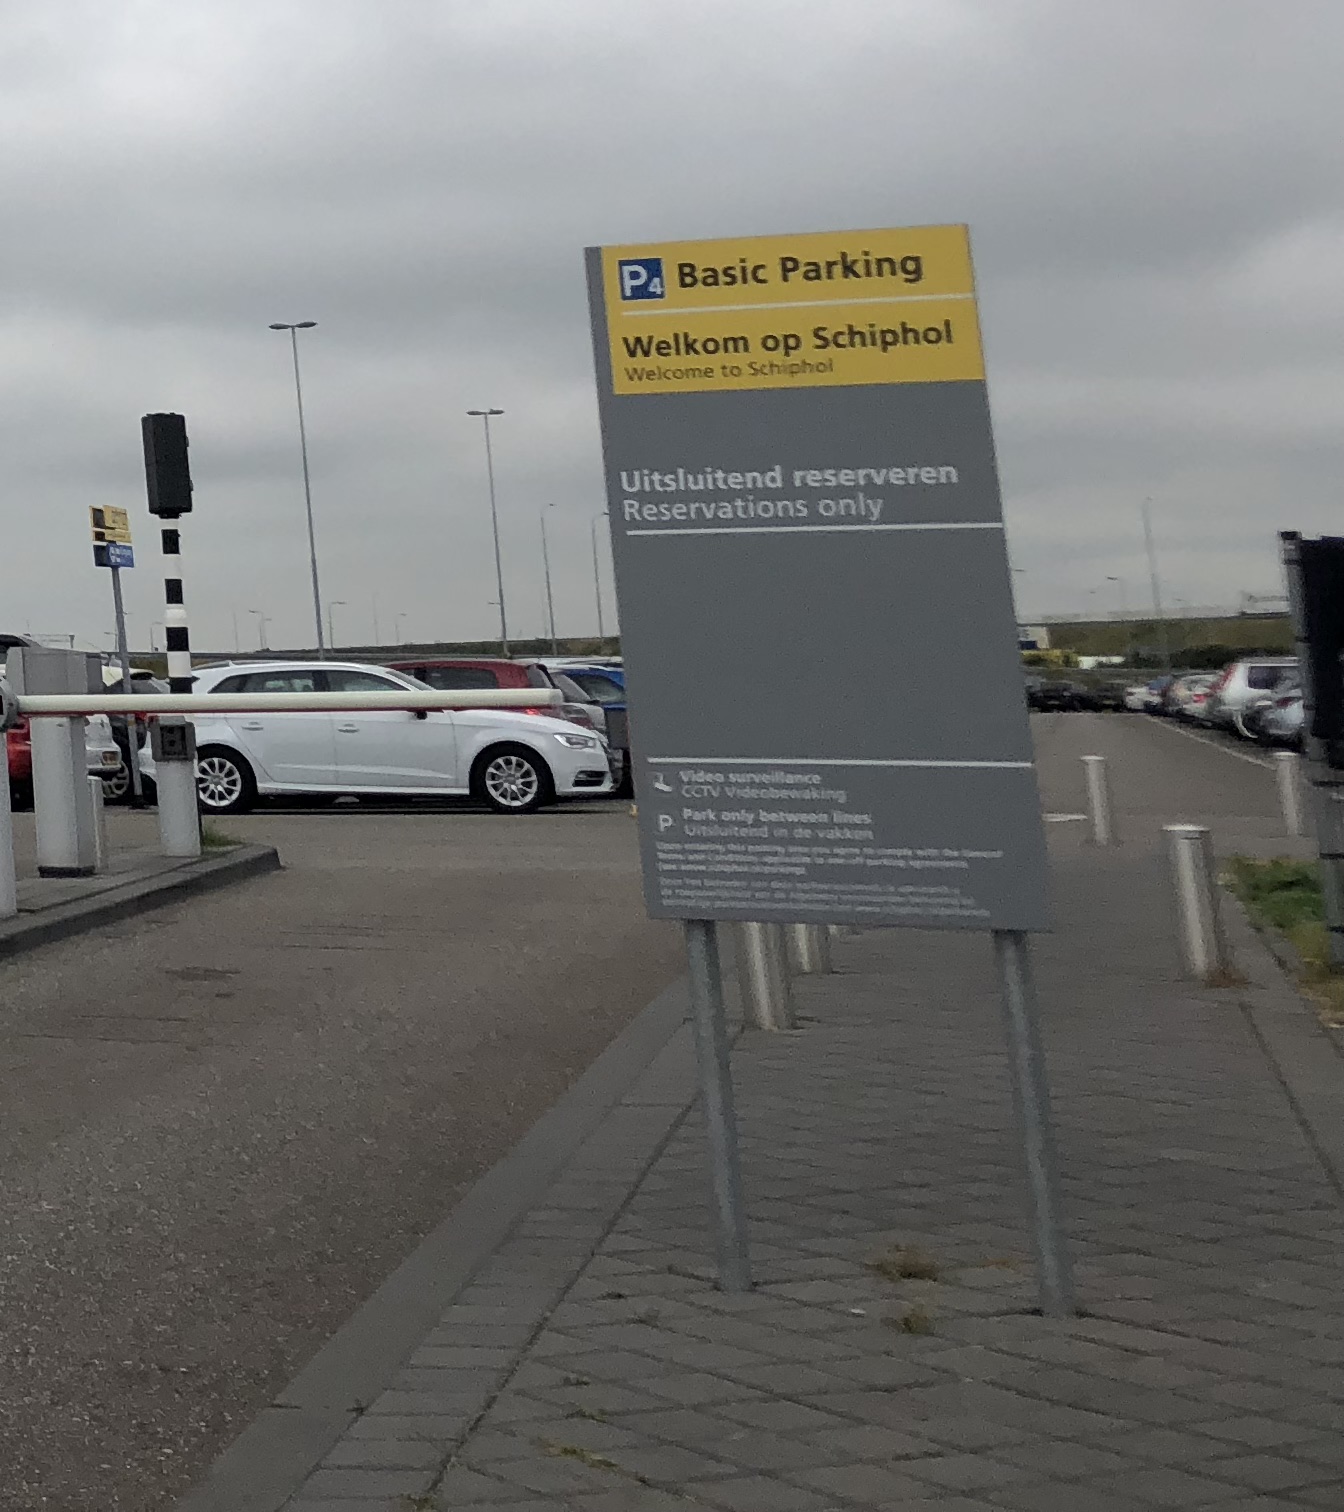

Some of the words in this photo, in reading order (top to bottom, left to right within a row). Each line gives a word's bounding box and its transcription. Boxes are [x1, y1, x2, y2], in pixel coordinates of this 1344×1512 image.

[677, 257, 768, 289] Basic
[780, 250, 924, 284] Parking
[622, 331, 750, 358] Welkom
[761, 330, 801, 357] op
[812, 319, 953, 352] Schiphol
[624, 364, 714, 382] Welcome
[721, 363, 742, 378] to
[748, 358, 834, 377] Schiphol
[620, 465, 782, 493] Uitsluitend
[793, 465, 959, 488] reserveren
[623, 495, 808, 521] Reservations
[817, 492, 885, 520] only
[679, 770, 724, 782] Video
[728, 771, 821, 784] surveillance
[681, 785, 720, 798] CCTV
[683, 807, 716, 820] Park
[721, 809, 754, 824] only
[759, 809, 828, 823] between
